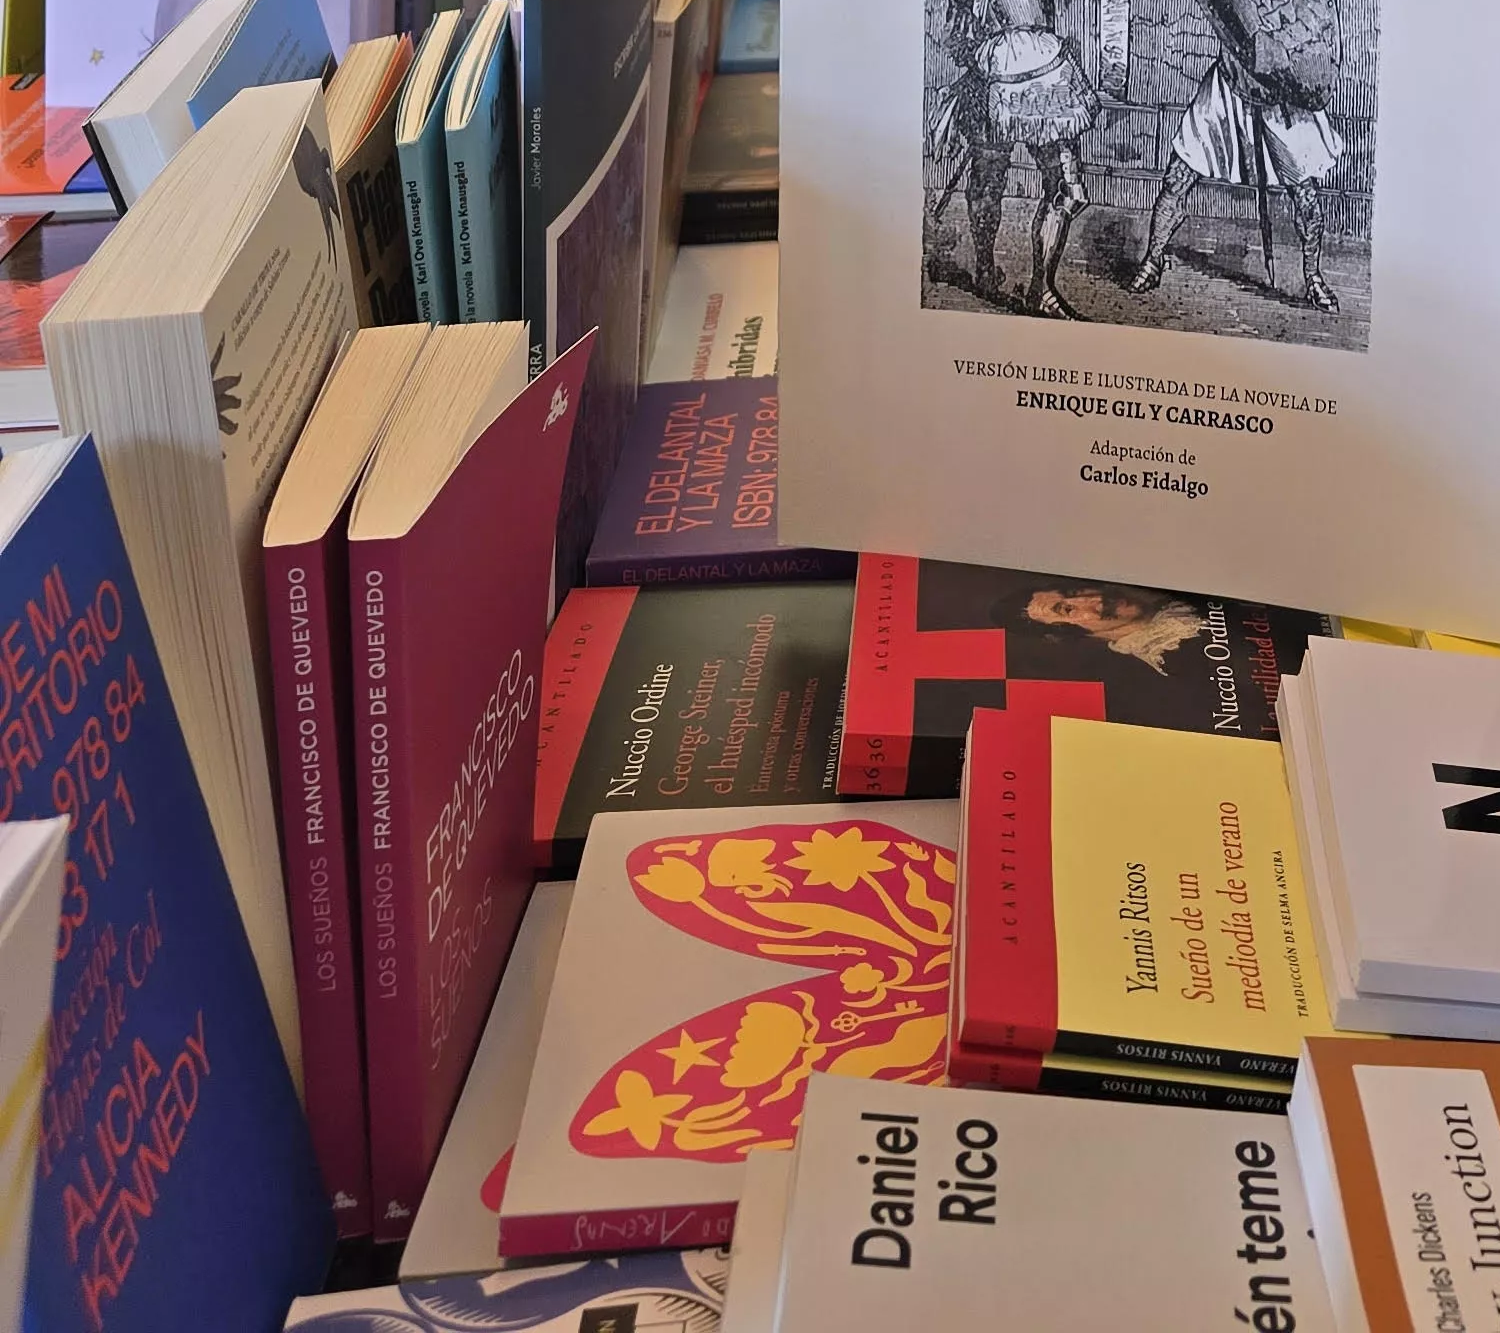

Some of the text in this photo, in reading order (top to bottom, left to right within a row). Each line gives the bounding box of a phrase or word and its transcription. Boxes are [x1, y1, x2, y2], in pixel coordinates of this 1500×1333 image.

[454, 161, 472, 217] Knausgård
[531, 107, 542, 190] Javier Morales
[406, 180, 428, 285] Karl Ove Knausgård
[460, 219, 470, 244] Ove
[461, 244, 471, 265] Karl
[953, 359, 1337, 416] VERSIÓN LIBRE E ILUSTRADA DE LA NOVELA DE
[1016, 390, 1274, 435] ENRIQUE GIL Y CARRASCO
[635, 393, 706, 535] EL DELANTAL
[677, 414, 738, 533] Y LA MAZA
[732, 466, 777, 528] ISBN:
[1079, 464, 1209, 499] Carlos Fidalgo
[1090, 440, 1196, 467] Adaptación de
[27, 564, 72, 656] MI
[622, 569, 644, 584] EL
[646, 564, 729, 583] DELANTAL
[877, 557, 896, 674] ACANTILADO
[658, 658, 726, 796] George Steiner,
[705, 613, 777, 795] el huésped incómodo
[1203, 602, 1241, 730] Nuccio Ordine
[53, 653, 145, 833] 978 84
[288, 568, 336, 992] LOS SUEÑOS FRANCISCO DE QUEVEDO
[367, 570, 397, 999] LOS SUEÑOS FRANCISCO DE QUEVEDO
[426, 649, 522, 883] FRANCISCO
[606, 663, 674, 798] Nuccio Ordine
[429, 675, 535, 944] DE QUEVEDO
[1003, 767, 1019, 947] ACANTILADO
[430, 906, 463, 1017] LOS
[1120, 861, 1160, 995] Yannis Ritsos
[1180, 871, 1216, 1005] Sueño de un
[1217, 801, 1266, 1013] mediodía de verano
[1273, 849, 1309, 1018] TRADUCCIÓN DE SELMA ANCIRA
[431, 875, 494, 1070] SUEÑOS
[1102, 1078, 1154, 1096] RITSOS
[1117, 1043, 1168, 1061] RITSOS
[1156, 1085, 1208, 1102] YANNIS
[1170, 1050, 1221, 1068] YANNIS
[63, 1036, 161, 1263] ALICIA
[83, 1009, 211, 1331] KENNEDY
[851, 1112, 919, 1269] Daniel
[937, 1118, 999, 1225] Rico
[1235, 1139, 1285, 1262] teme
[1418, 1190, 1464, 1333] Charles Dickens
